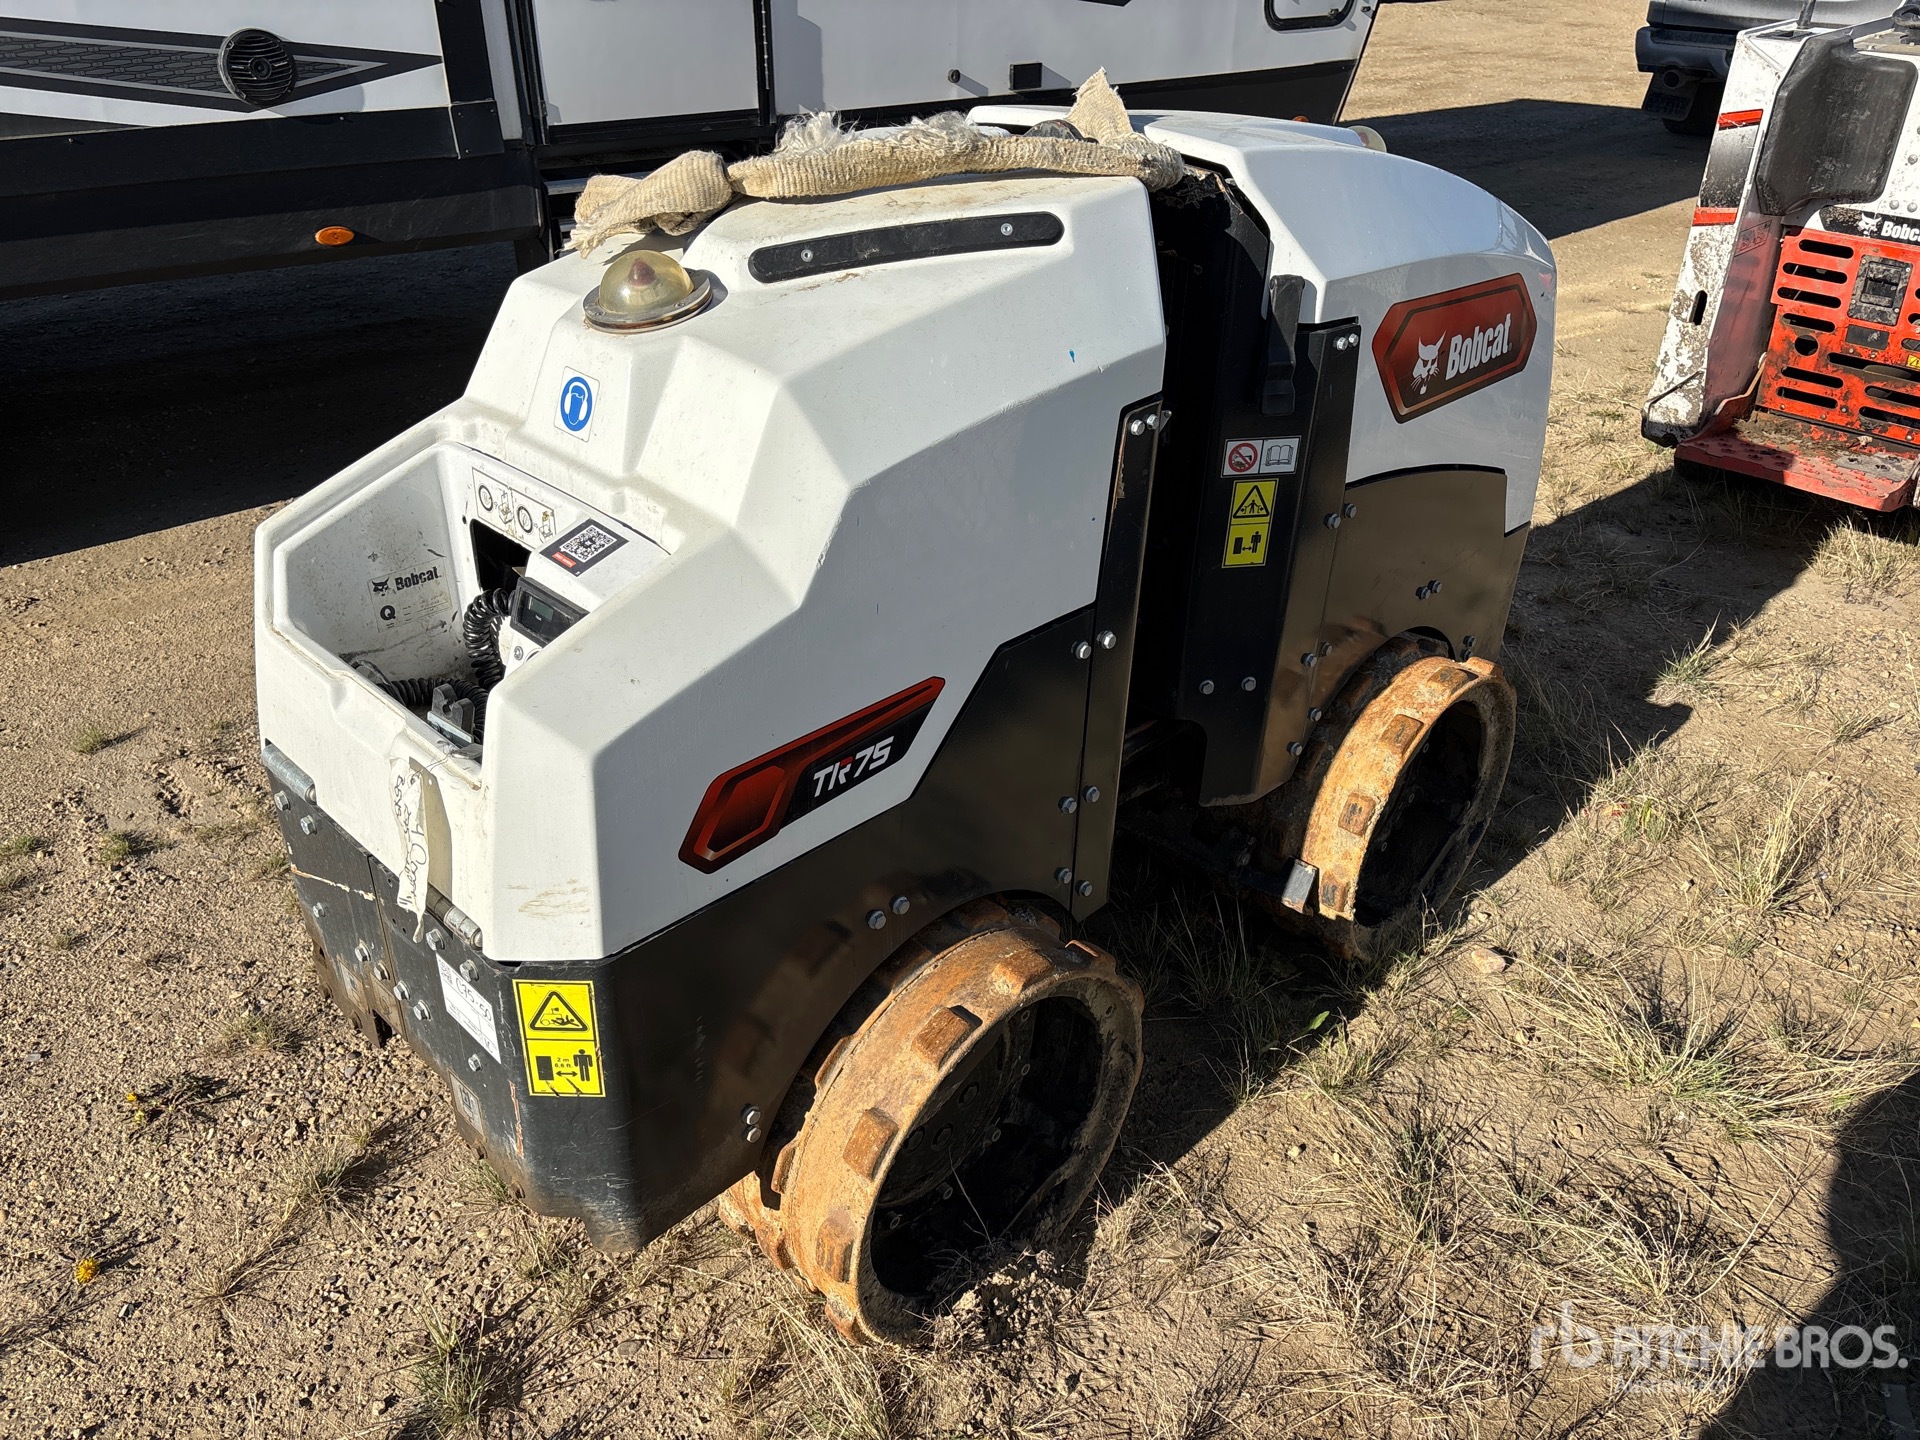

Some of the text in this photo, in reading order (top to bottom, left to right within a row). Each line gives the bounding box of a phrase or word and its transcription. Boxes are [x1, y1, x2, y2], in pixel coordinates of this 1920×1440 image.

[1445, 312, 1512, 381] Bobcat
[394, 566, 440, 591] Bobcat
[380, 604, 397, 621] Q
[813, 735, 895, 798] TR75
